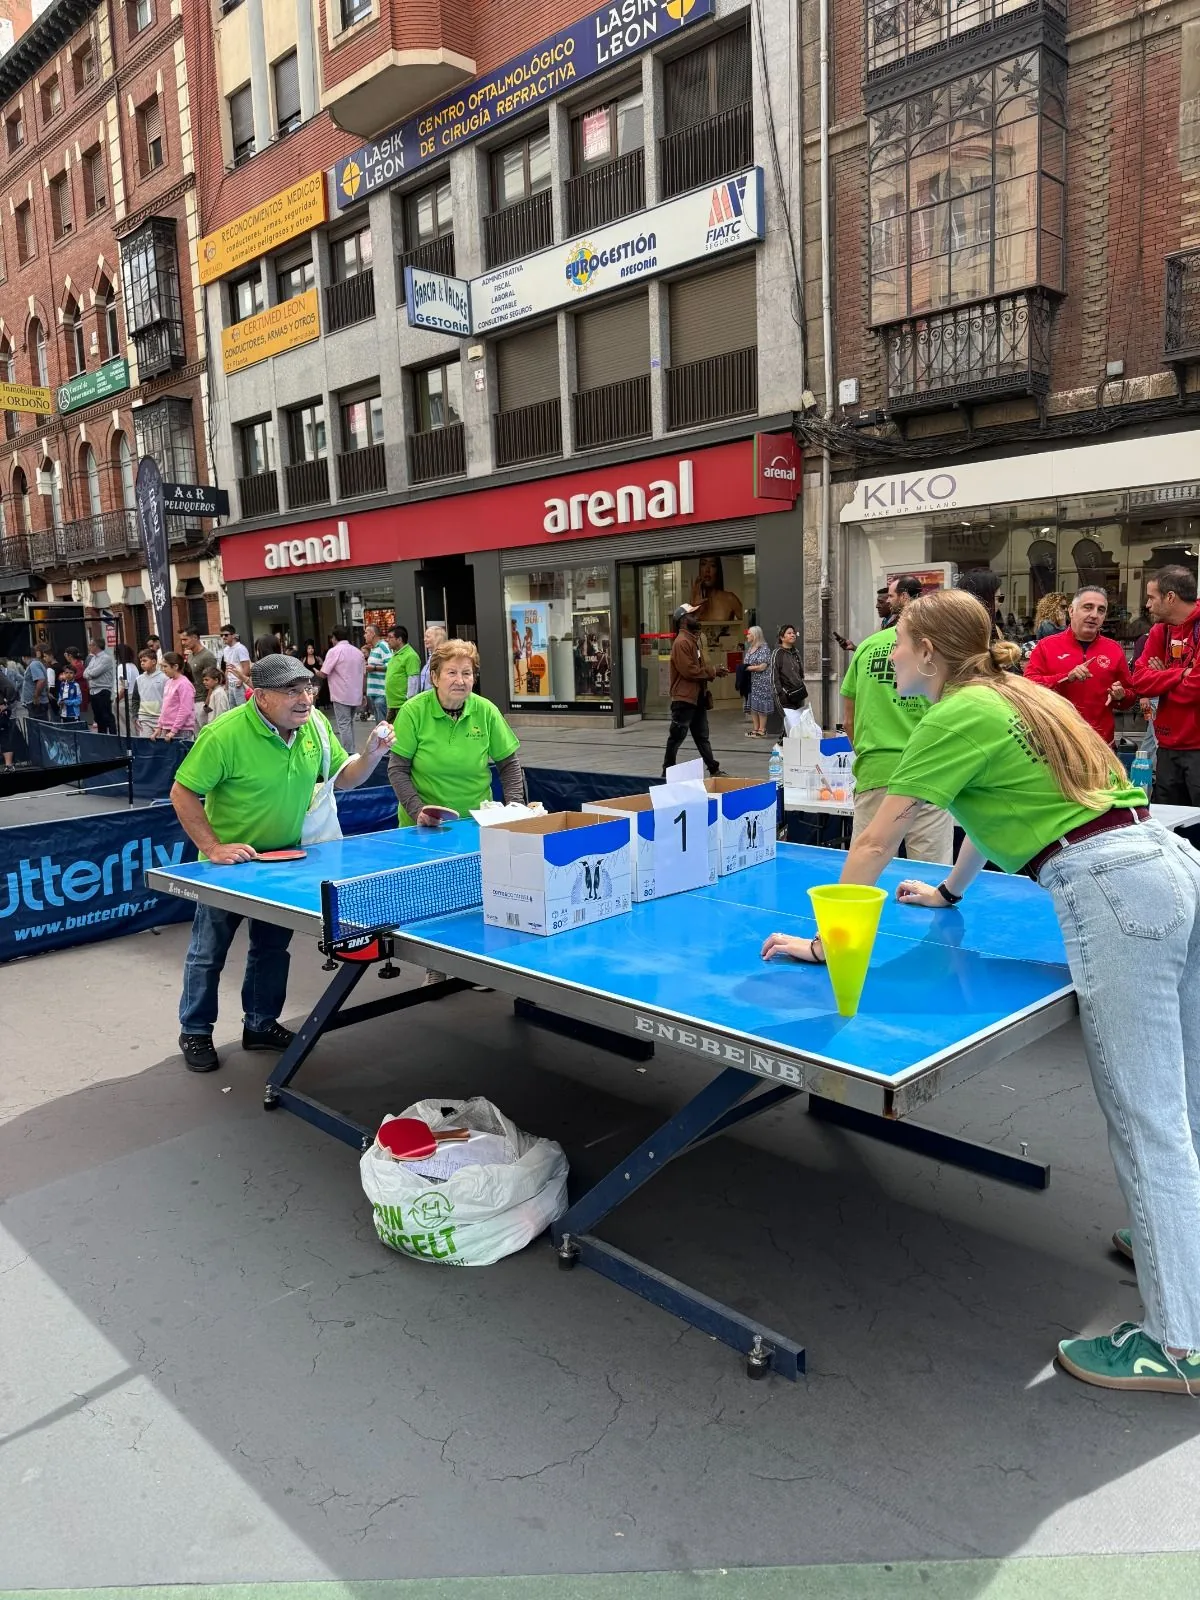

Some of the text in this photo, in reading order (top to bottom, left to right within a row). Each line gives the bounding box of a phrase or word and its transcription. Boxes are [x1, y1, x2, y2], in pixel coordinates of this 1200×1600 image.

[597, 12, 657, 64] LEON
[418, 38, 575, 137] CENTRO OFTALMOLÓGICO
[420, 61, 576, 158] DE CIRUGÍA REFRACTIVA
[364, 131, 404, 167] LASIK
[365, 153, 405, 190] LEON
[221, 177, 321, 242] RECONOCIMIENTOS MEDICOS
[226, 197, 318, 253] conductores, armas, seguridad,
[232, 214, 313, 262] animales peligrosos y otros
[705, 233, 741, 251] SEGUROS
[706, 220, 741, 244] FIATC
[565, 232, 657, 280] EUROGESTIÓN
[620, 257, 657, 278] ASESORÍA
[481, 265, 524, 287] ADMINISTRATIVA
[494, 281, 511, 293] FISCAL
[490, 300, 518, 315] CONTABLE
[491, 290, 515, 304] LABORAL
[243, 298, 306, 336] CERTIMED LEON
[478, 305, 532, 330] CONSULTING SEGUROS
[224, 335, 267, 359] CONDUCTORES,
[267, 324, 288, 342] ARMAS
[289, 321, 294, 332] Y
[294, 313, 316, 330] OTROS
[3, 383, 45, 397] Inmobiliaria
[7, 395, 50, 410] ORDOÑO
[763, 466, 796, 481] arenal
[864, 473, 957, 510] KIKO
[164, 500, 216, 512] PELUQUEROS
[174, 486, 184, 498] A
[196, 488, 205, 500] R
[543, 459, 694, 534] arenal
[864, 510, 890, 518] MAKE
[916, 501, 958, 511] MILANO
[264, 521, 351, 570] arenal
[673, 809, 687, 852] 1
[14, 897, 159, 941] www.butterfly.tt
[553, 920, 563, 930] 80
[635, 1015, 801, 1083] ENEBE NB
